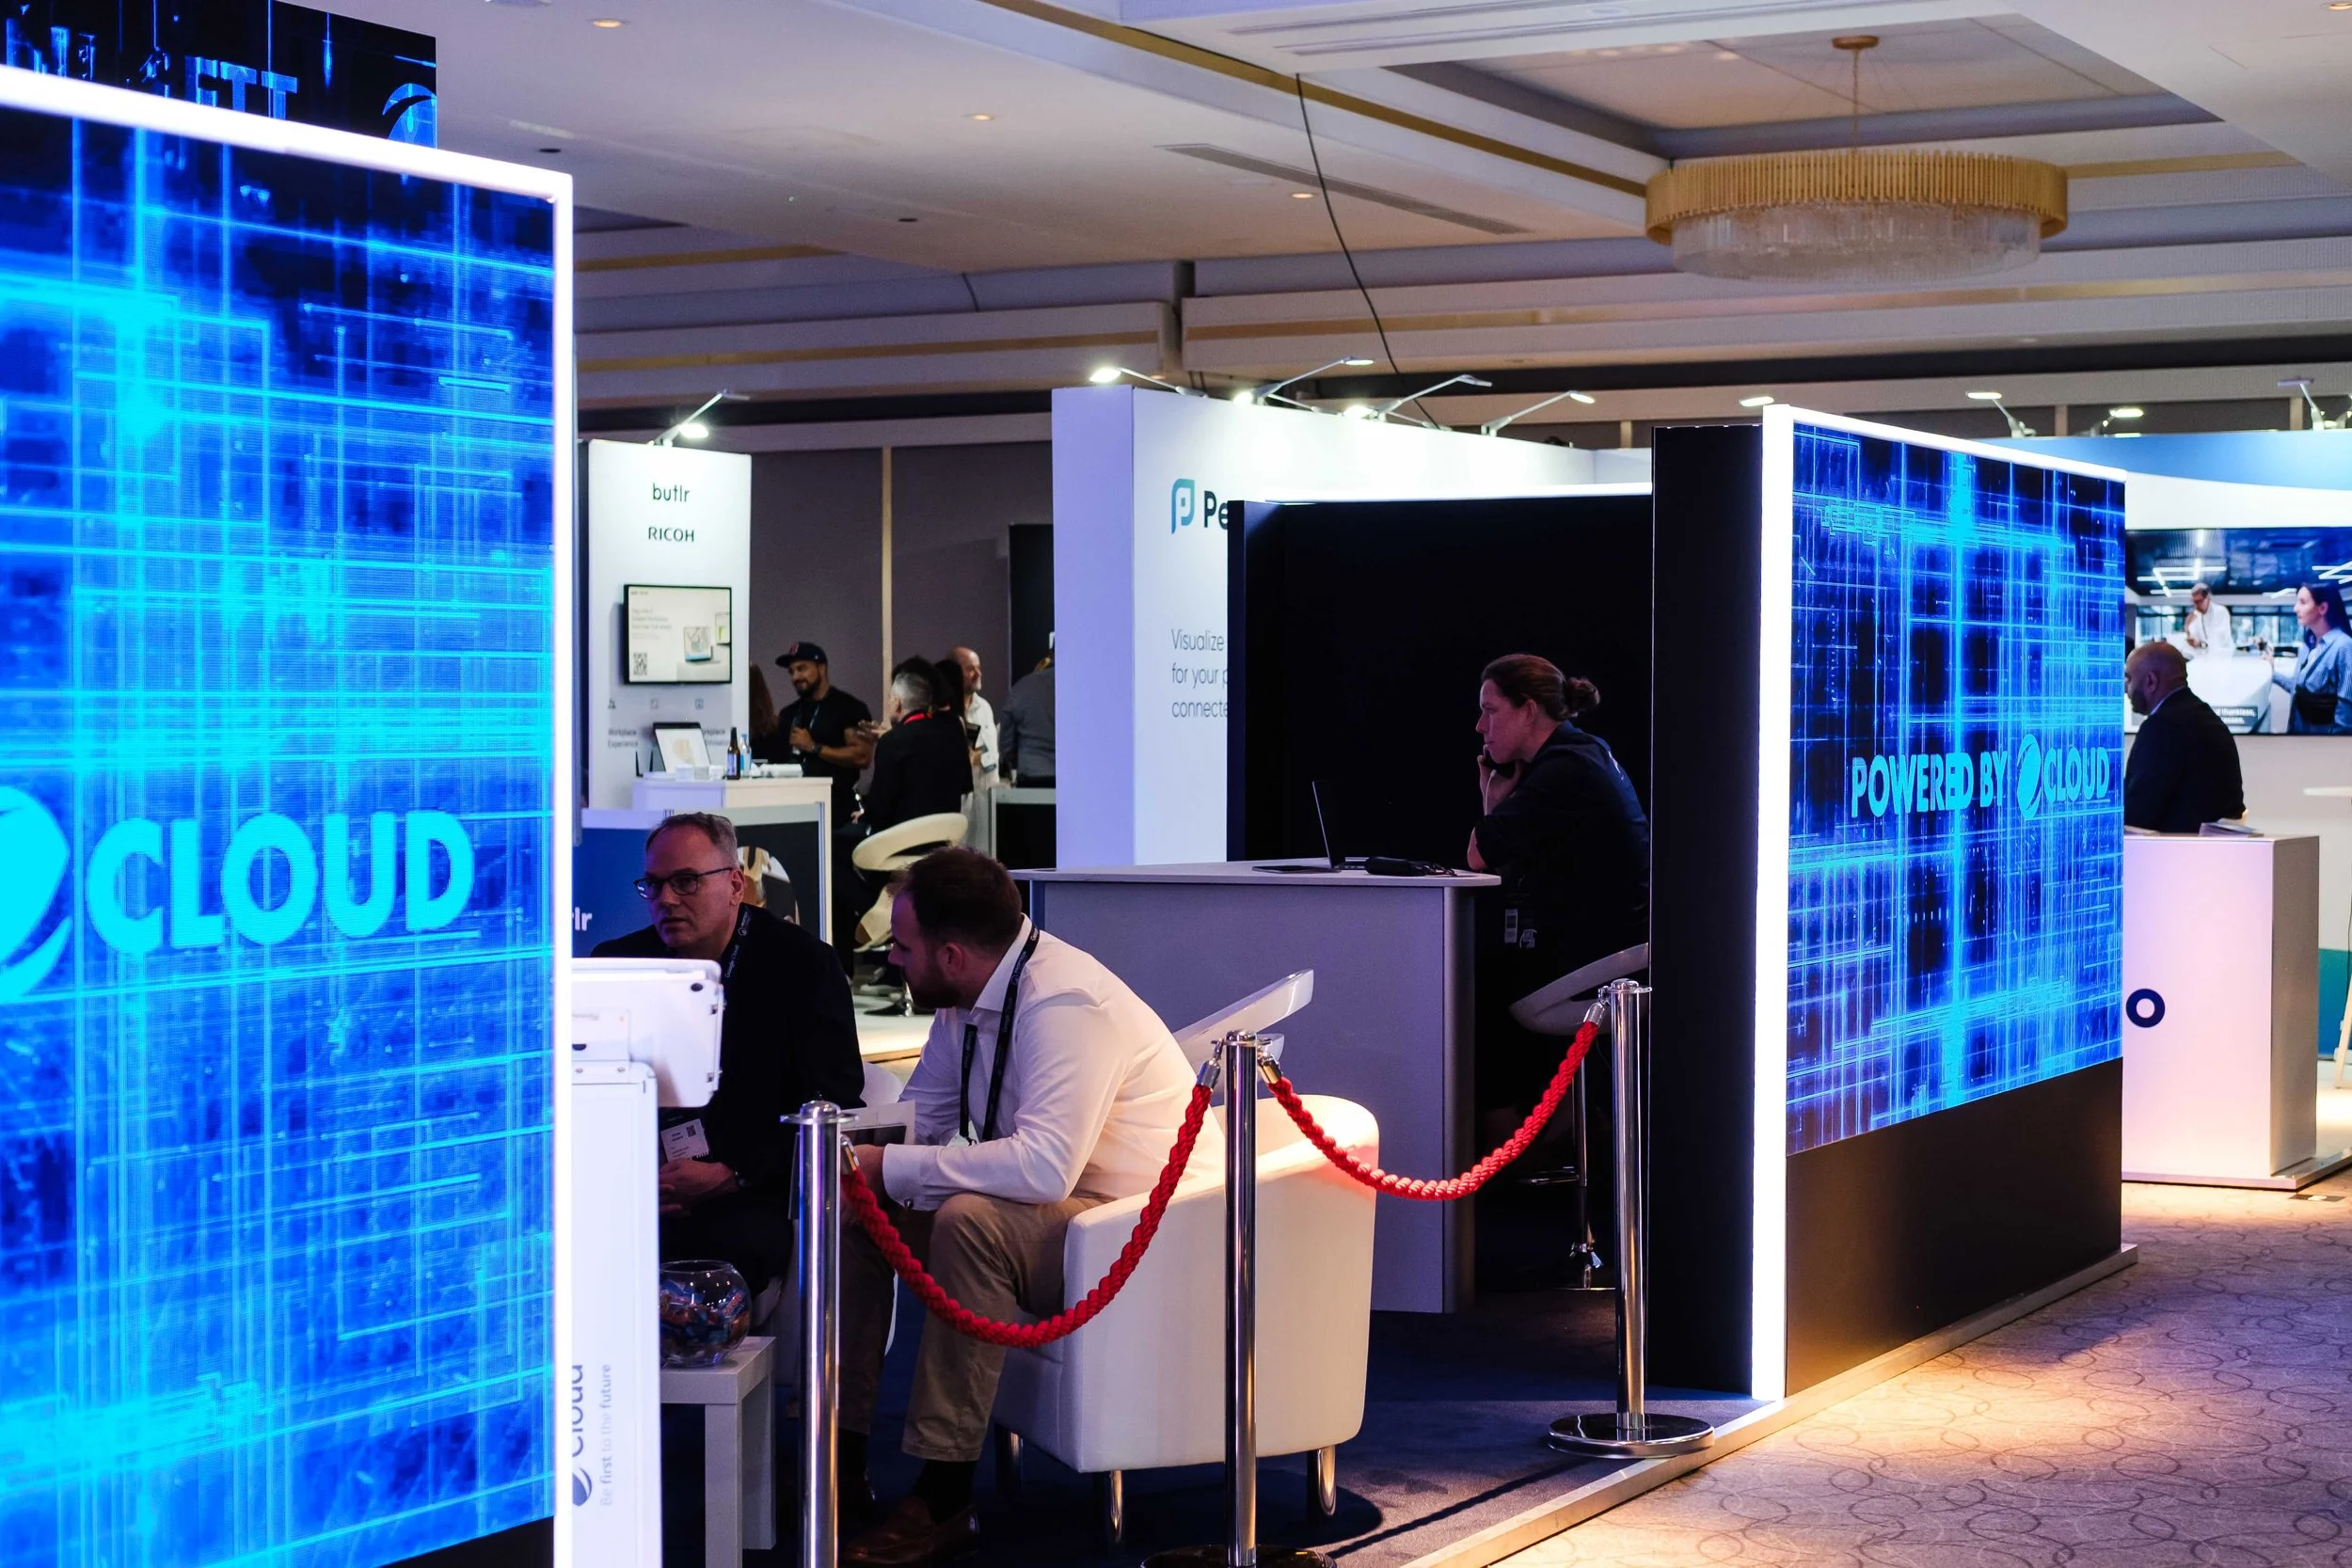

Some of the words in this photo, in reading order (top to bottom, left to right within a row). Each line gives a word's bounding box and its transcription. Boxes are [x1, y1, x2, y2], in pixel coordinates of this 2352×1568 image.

[652, 482, 691, 503] butlr
[648, 526, 695, 543] RICOH
[1171, 628, 1225, 651] Visualize
[1172, 662, 1188, 684] for
[1192, 669, 1218, 689] your
[1851, 752, 1974, 817] POWERED
[1979, 751, 2008, 807] BY
[2043, 746, 2110, 804] CLOUD
[87, 810, 475, 951] CLOUD
[599, 1365, 612, 1409] future
[599, 1456, 612, 1484] first
